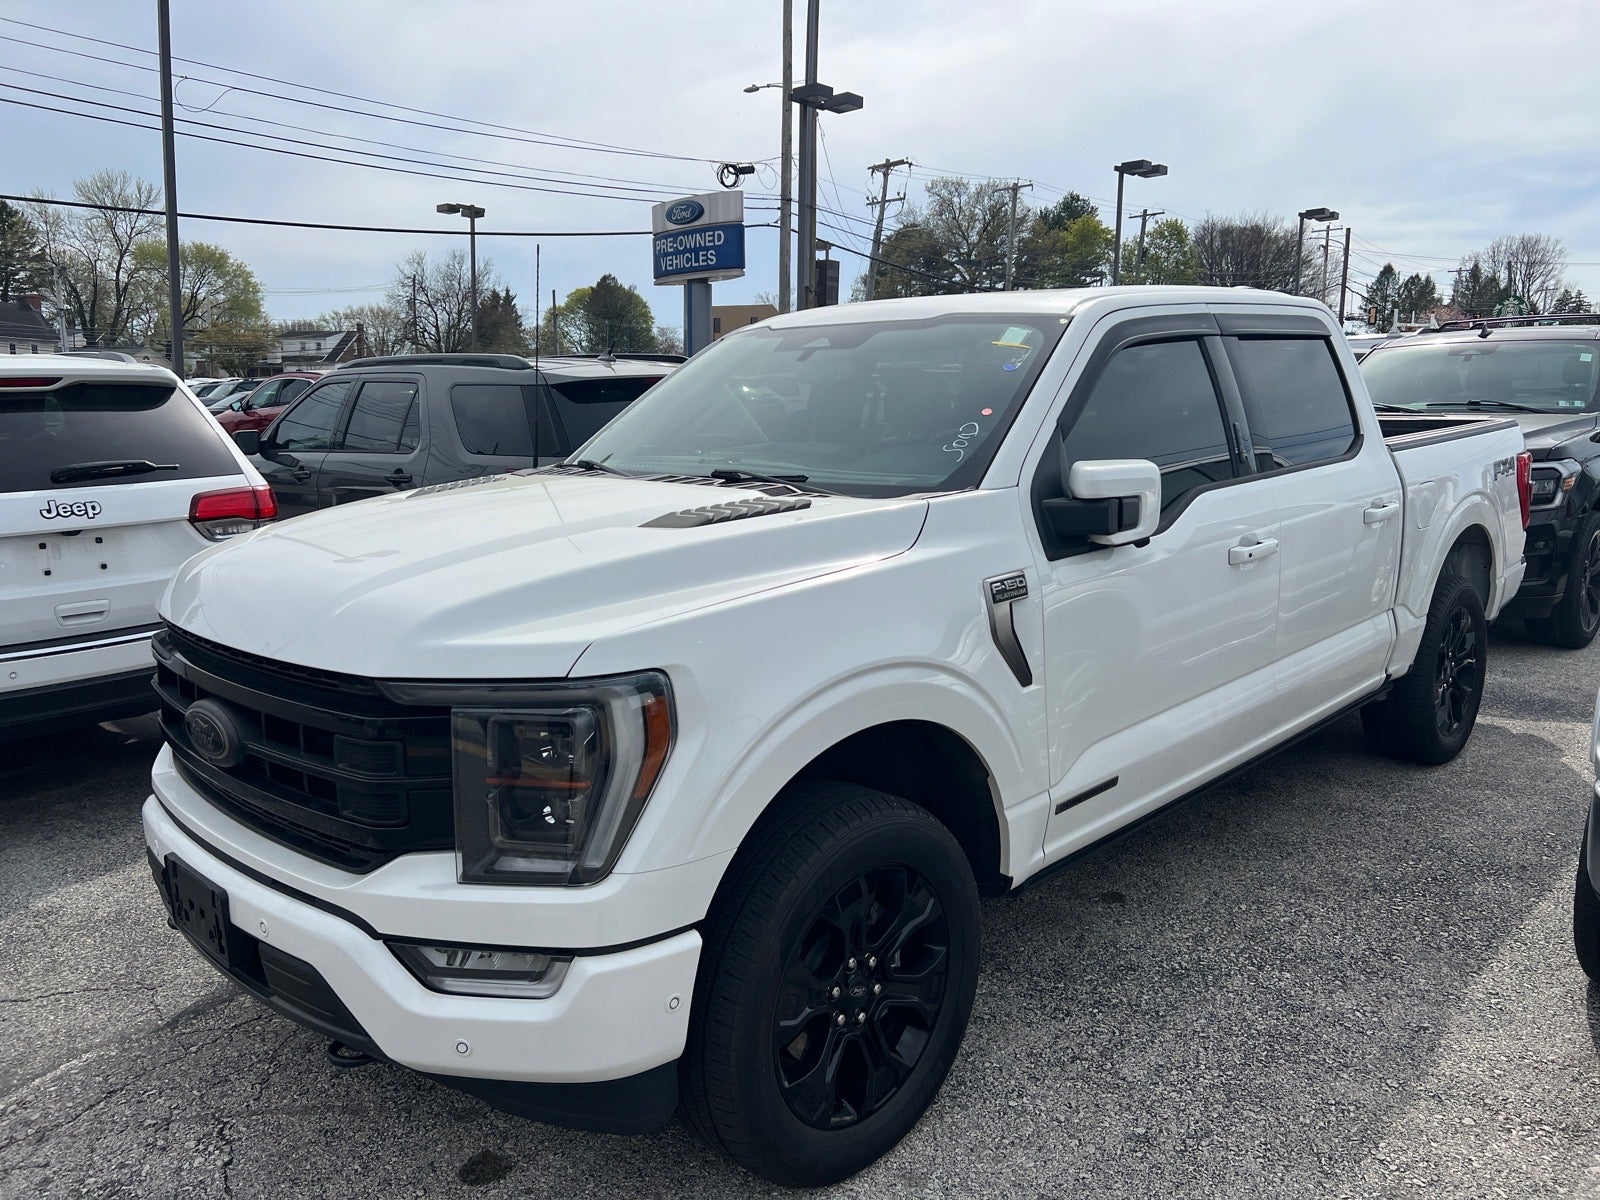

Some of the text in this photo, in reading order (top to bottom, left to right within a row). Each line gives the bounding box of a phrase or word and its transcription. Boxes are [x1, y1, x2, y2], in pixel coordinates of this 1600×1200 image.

[671, 204, 692, 220] Ford
[656, 231, 725, 254] PRE-OWNED
[660, 250, 717, 271] VEHICLES
[1493, 456, 1515, 481] FX4
[40, 499, 102, 519] Jeep
[991, 577, 1026, 593] F-150
